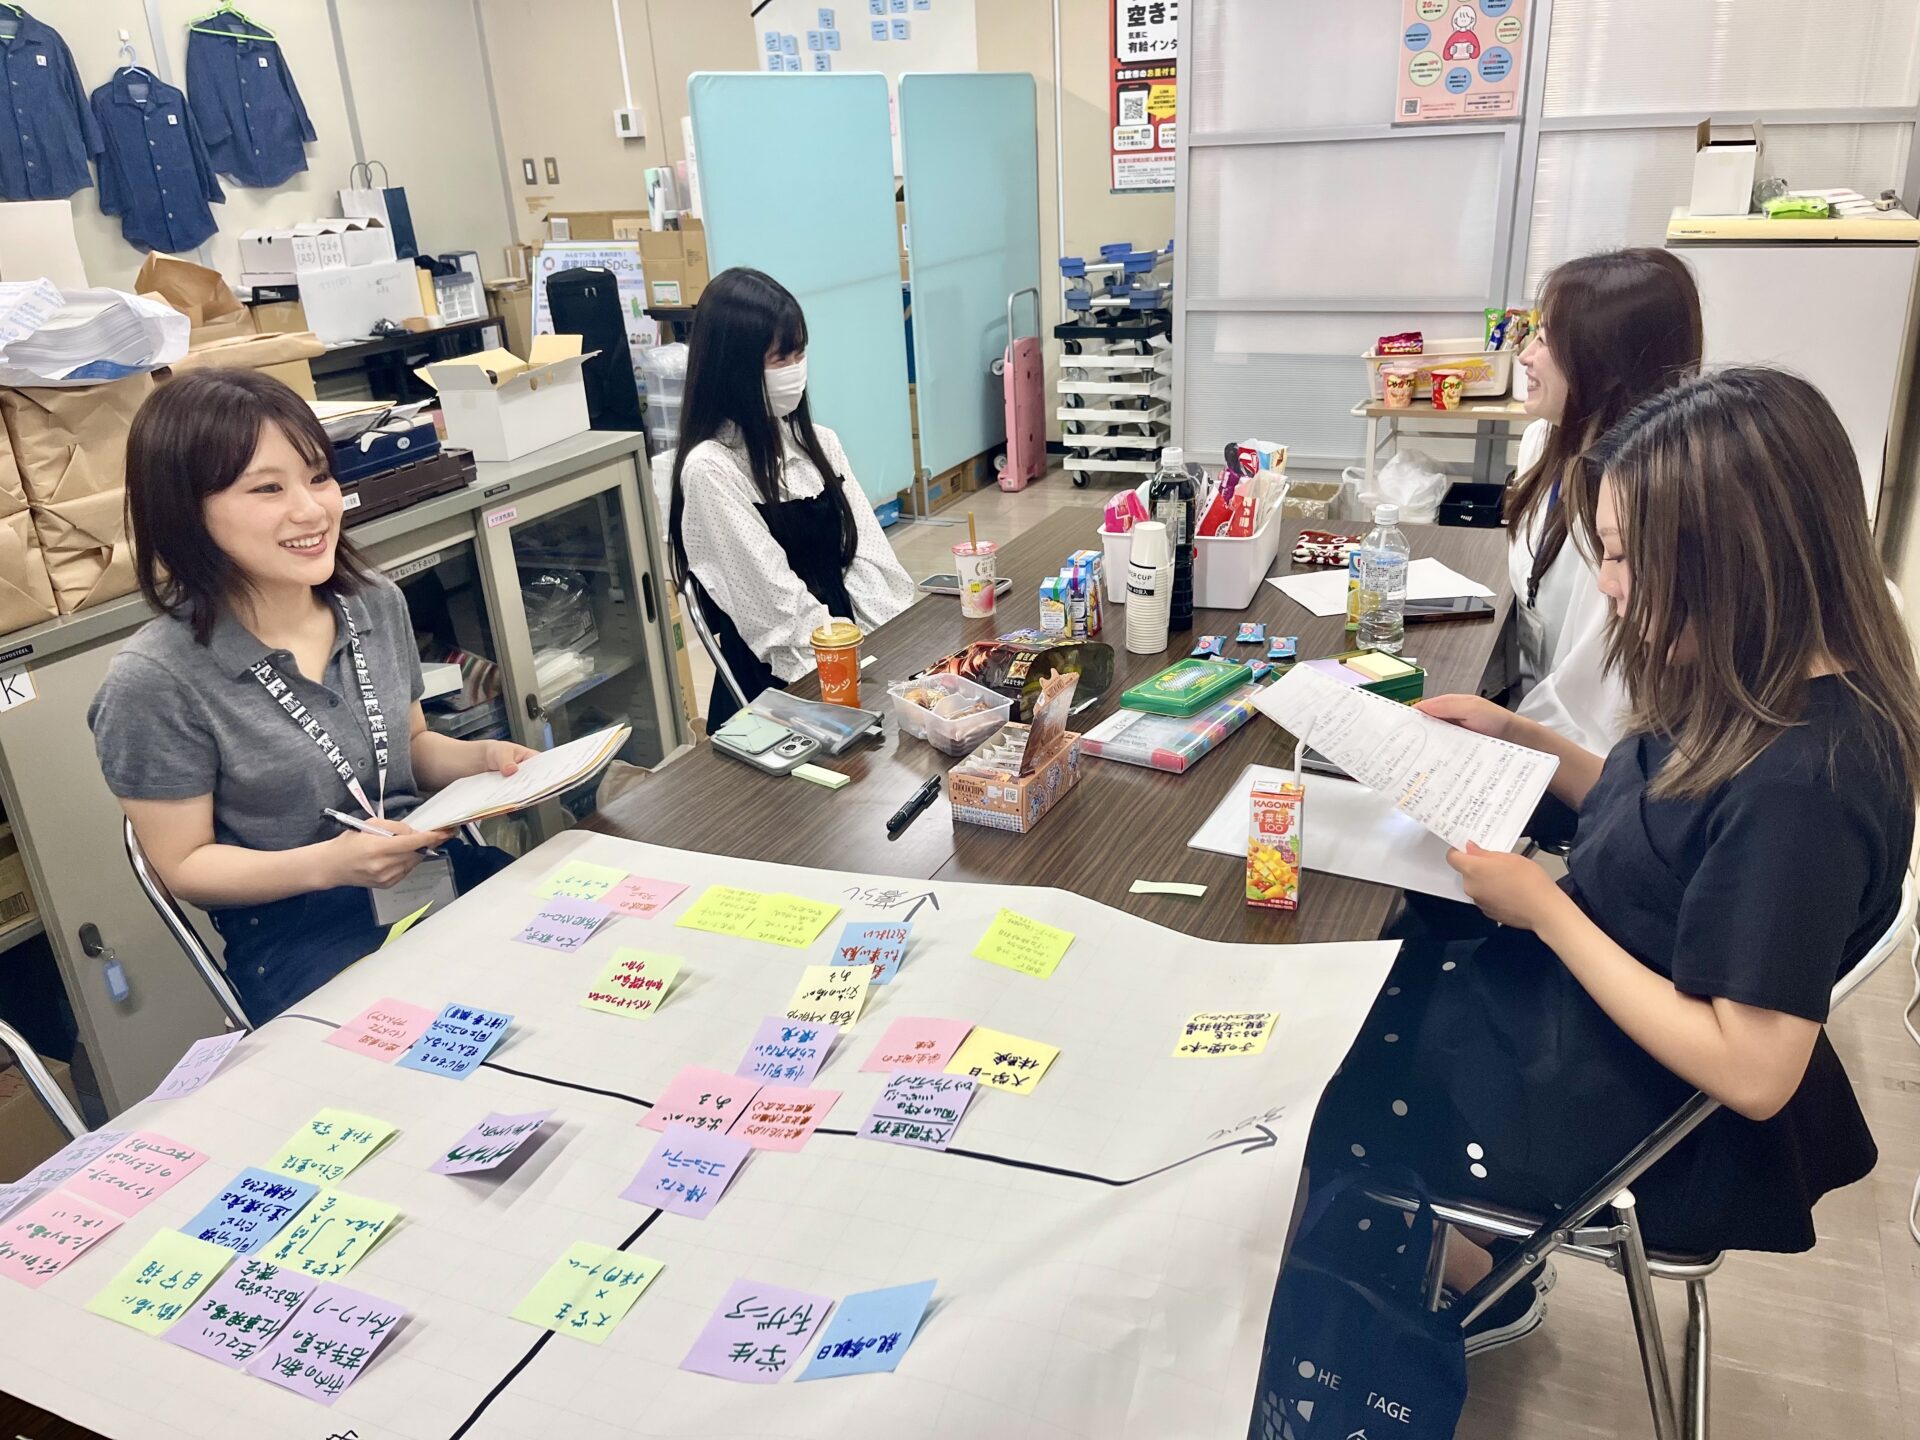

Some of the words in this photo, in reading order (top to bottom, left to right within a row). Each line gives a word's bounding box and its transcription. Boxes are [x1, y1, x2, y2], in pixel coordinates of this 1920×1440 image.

[0, 674, 25, 704] K
[1254, 800, 1295, 809] KAGOME
[1254, 812, 1295, 826] 野菜生活
[1264, 824, 1284, 832] 100
[621, 961, 645, 972] 少ない
[829, 970, 852, 983] ある
[781, 1026, 818, 1043] 環境
[419, 1053, 470, 1072] 同じものを
[754, 1062, 804, 1081] 性別に
[992, 1052, 1040, 1070] 体験
[698, 1094, 731, 1110] ある
[662, 1113, 723, 1130] 出会いが
[870, 1120, 951, 1144] 大学間連携
[655, 1178, 707, 1203] 様々な
[219, 1216, 257, 1233] だけど
[134, 1260, 205, 1290] 目安箱
[239, 1259, 280, 1280] 機会
[119, 1295, 183, 1321] 職場に
[199, 1298, 281, 1340] 仕事現場を
[312, 1297, 397, 1339] ネットワーク
[555, 1303, 611, 1328] 大学生
[724, 1296, 813, 1336] キッザニア
[291, 1329, 369, 1370] 若手社員の
[728, 1341, 787, 1372] 学生
[816, 1332, 901, 1360] 親の参観日
[270, 1352, 346, 1396] 市内の新人
